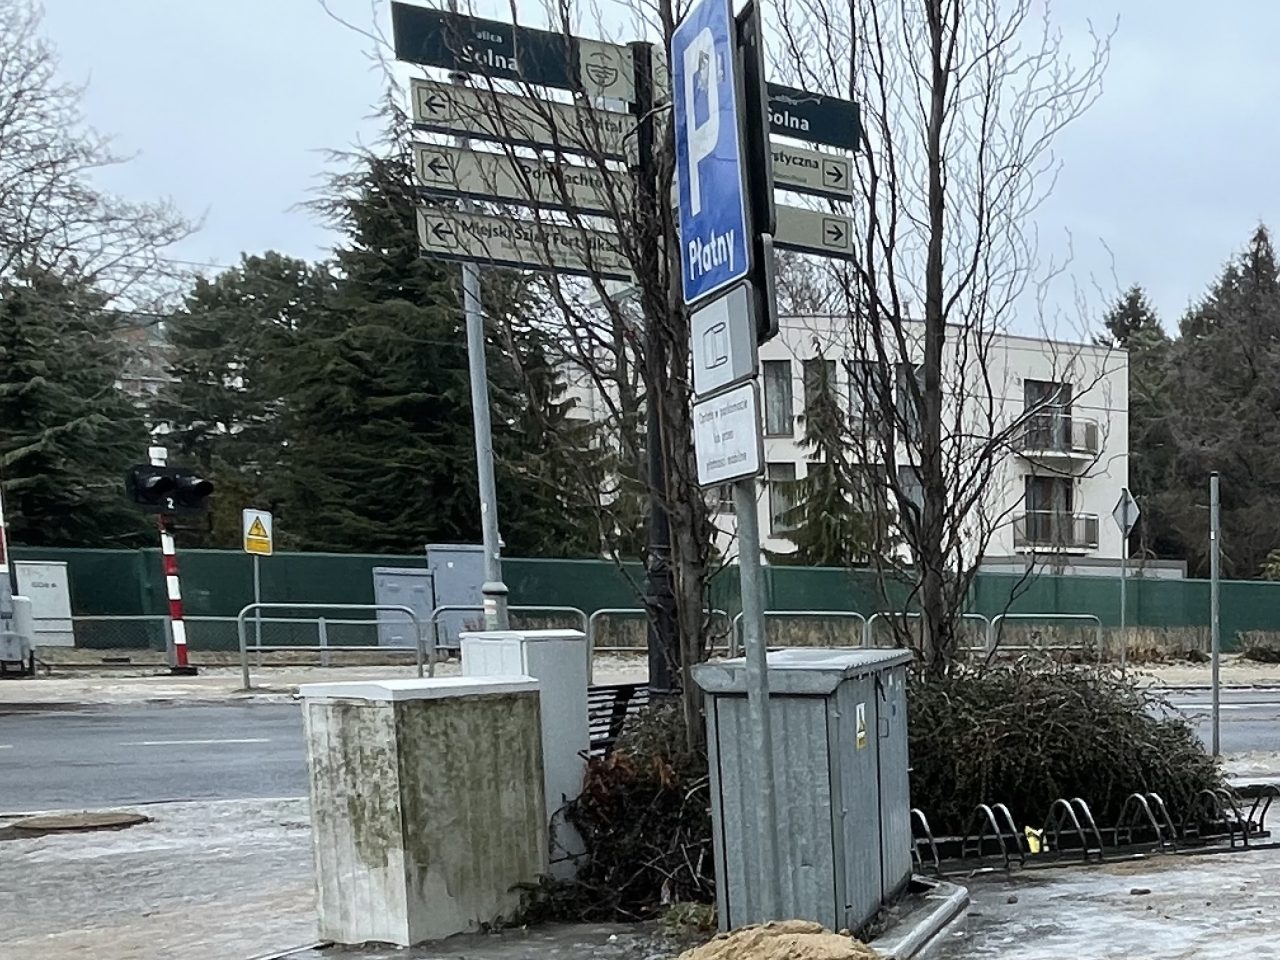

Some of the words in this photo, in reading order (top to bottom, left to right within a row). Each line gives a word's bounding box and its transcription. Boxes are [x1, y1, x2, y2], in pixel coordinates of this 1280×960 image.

[462, 45, 518, 71] Solna
[684, 26, 720, 217] P
[773, 151, 819, 169] styczna
[688, 229, 735, 280] Płatny
